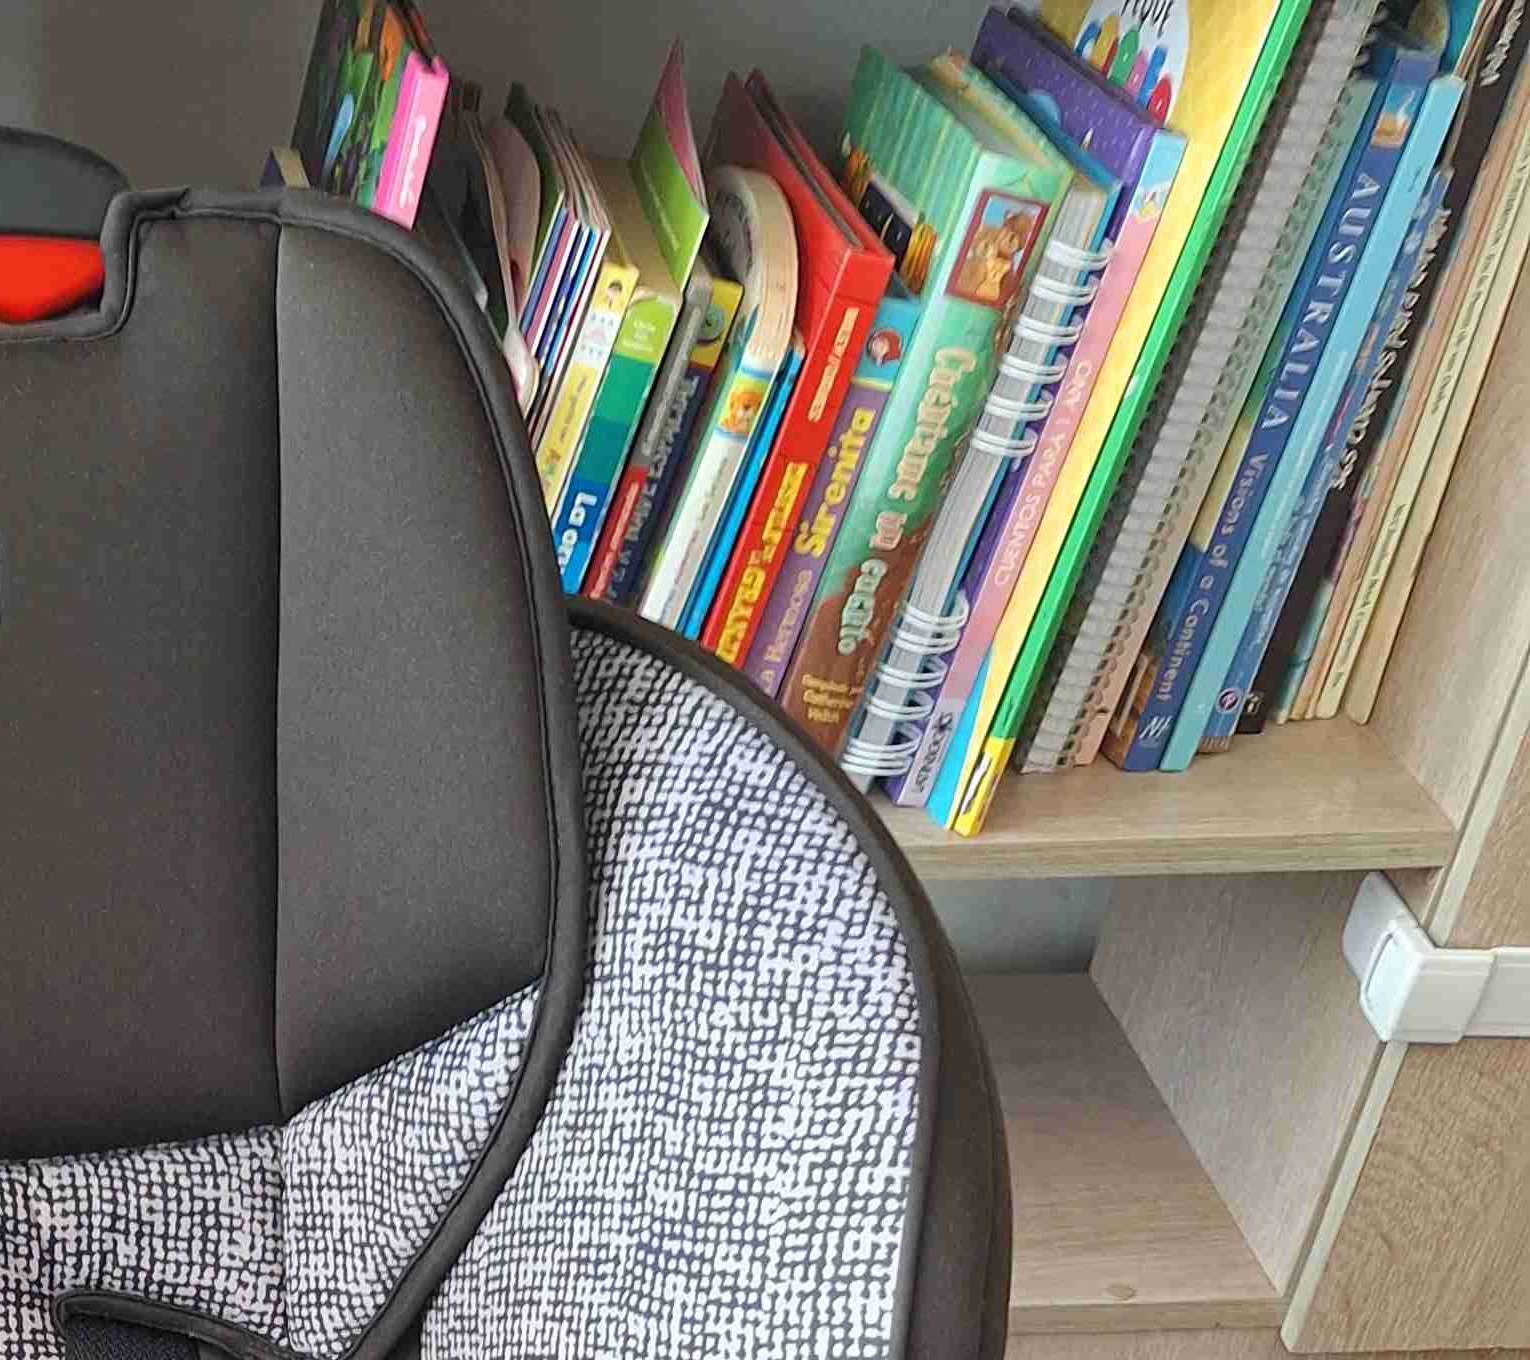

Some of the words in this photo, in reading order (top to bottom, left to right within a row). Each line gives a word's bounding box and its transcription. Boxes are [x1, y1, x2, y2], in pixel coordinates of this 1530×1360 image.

[1261, 172, 1381, 430] AUSTRALIA
[794, 406, 877, 559] Sirenita
[993, 494, 1041, 587] CUENTOS
[1032, 432, 1066, 487] PARA
[1221, 448, 1270, 536] Visions
[1208, 543, 1229, 569] of
[1156, 599, 1210, 702] Continent
